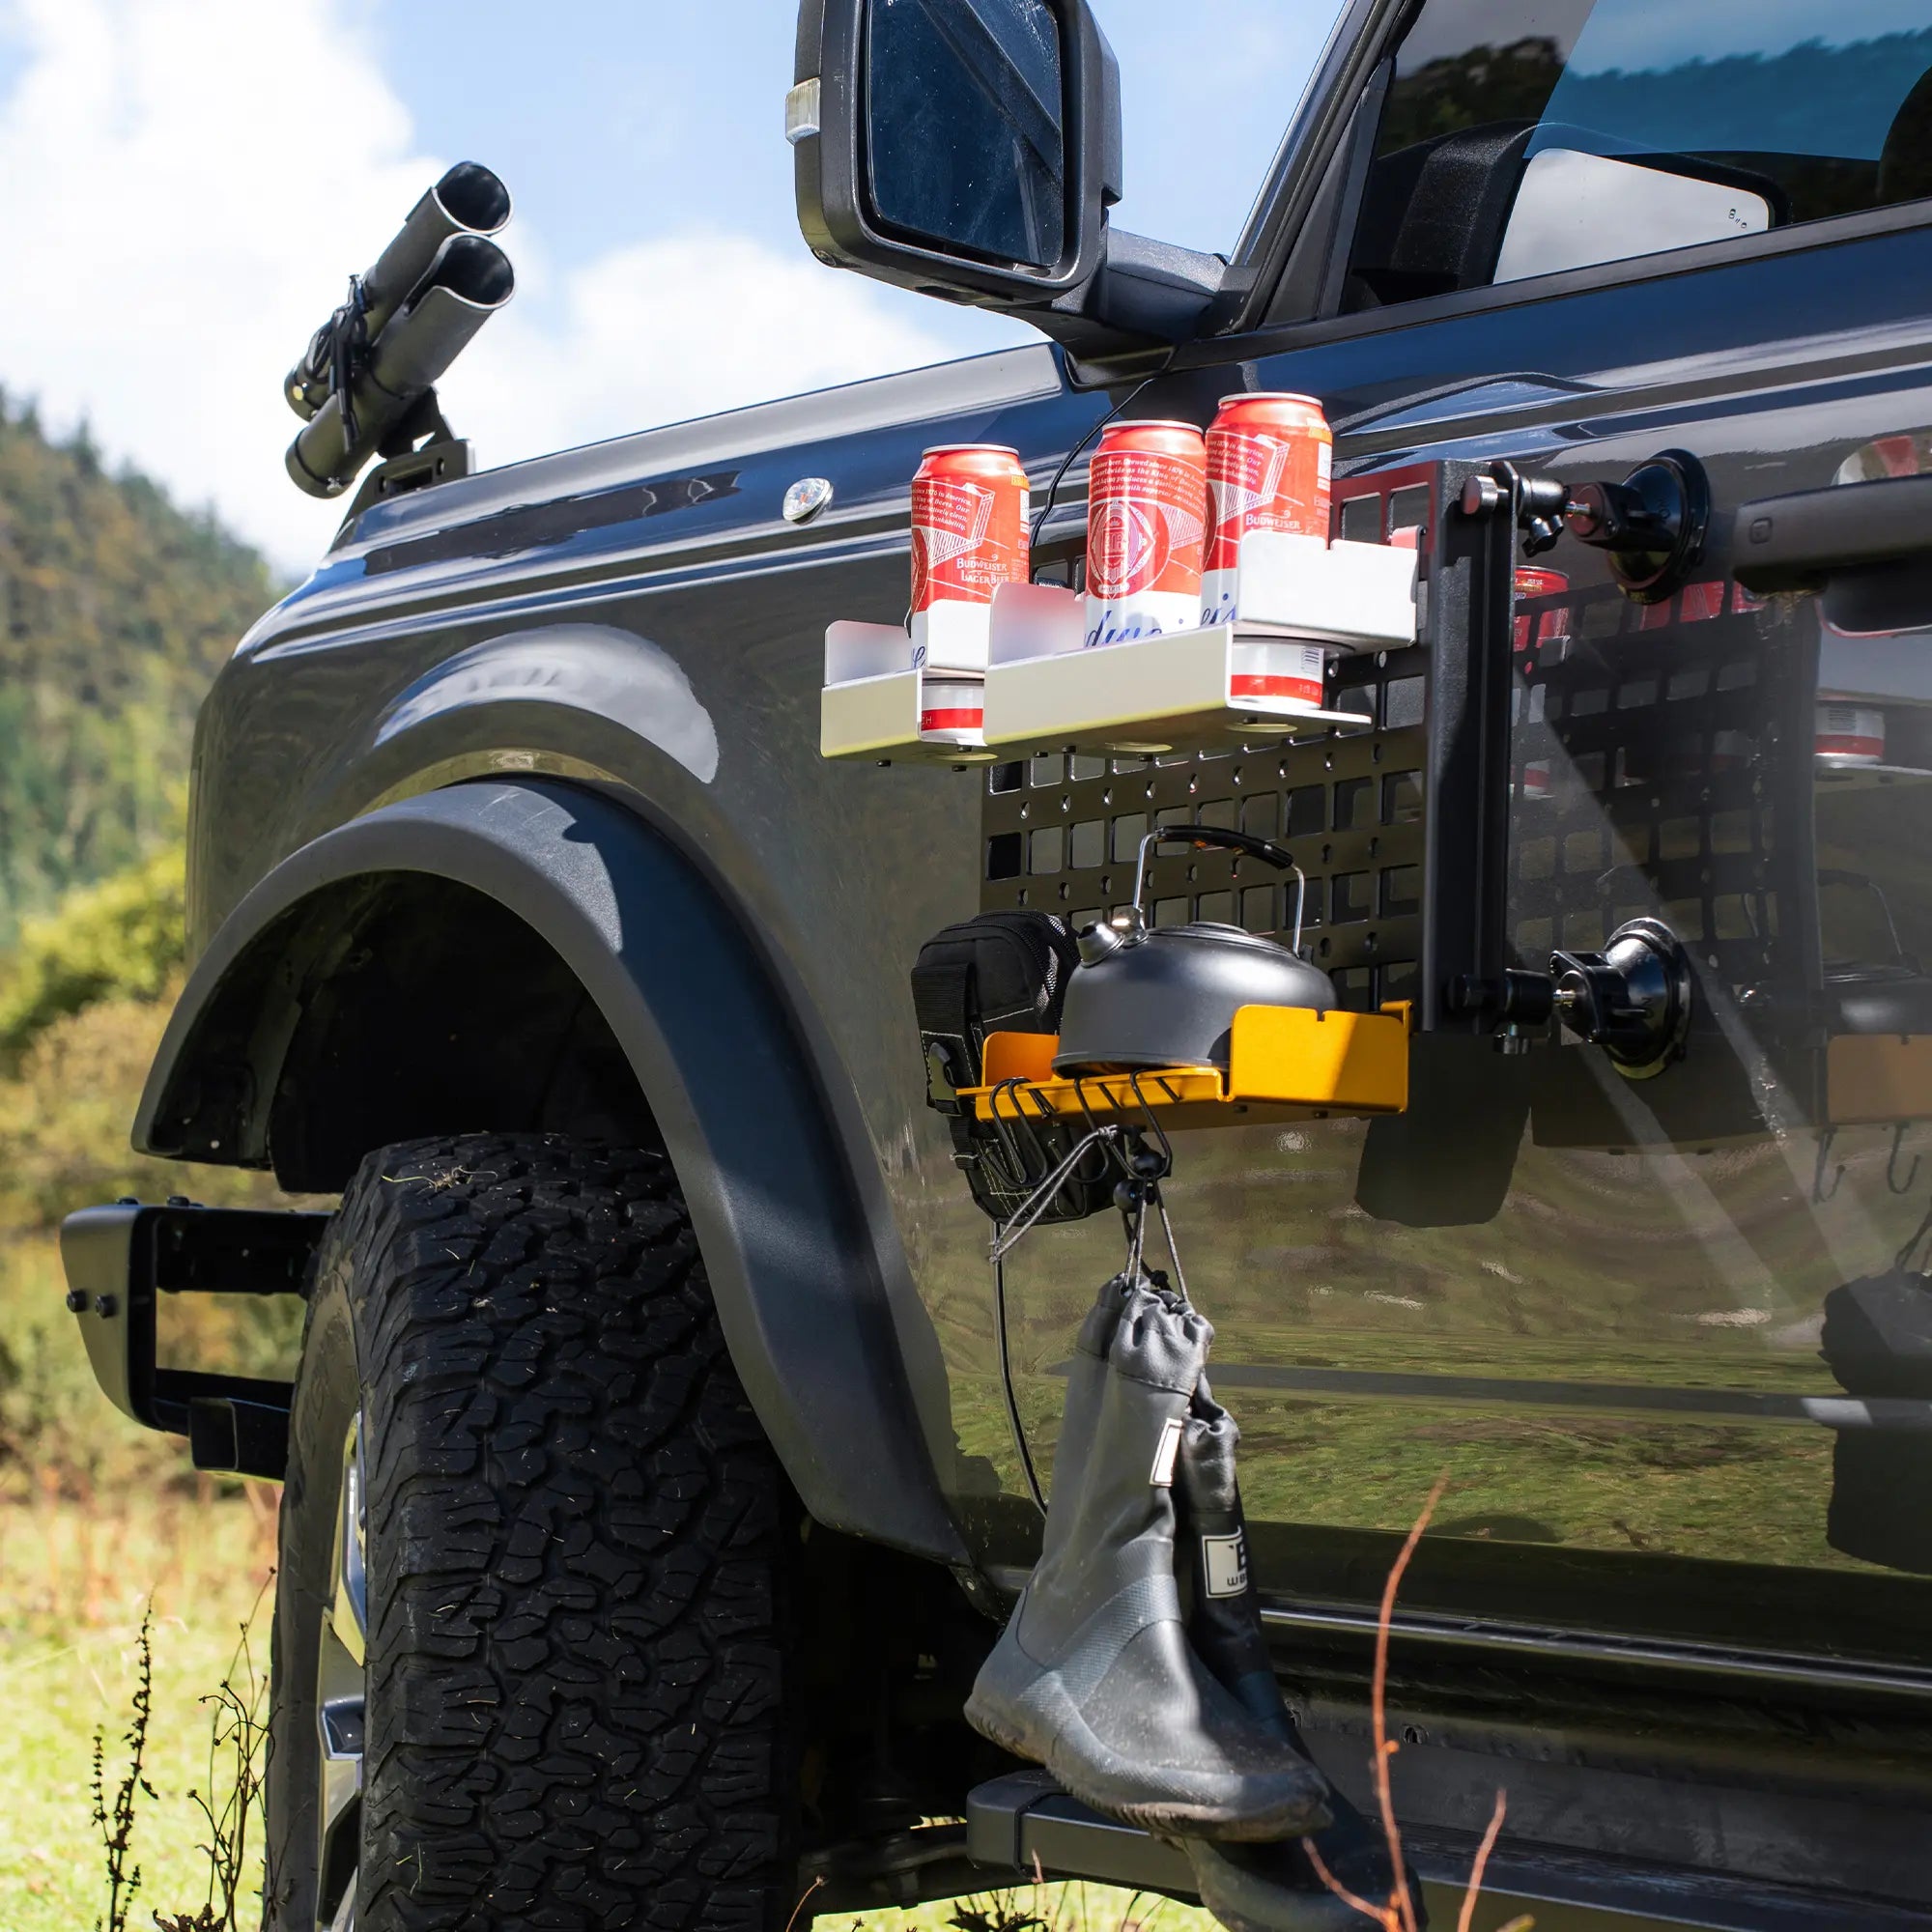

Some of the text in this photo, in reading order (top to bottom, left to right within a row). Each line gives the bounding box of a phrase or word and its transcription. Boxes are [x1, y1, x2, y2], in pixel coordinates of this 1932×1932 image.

[1247, 458, 1262, 467] Our
[956, 504, 970, 513] Our
[1245, 513, 1301, 529] BUDWEISER
[956, 557, 1008, 572] BUDWEISER
[961, 569, 1009, 584] LAGER BEER
